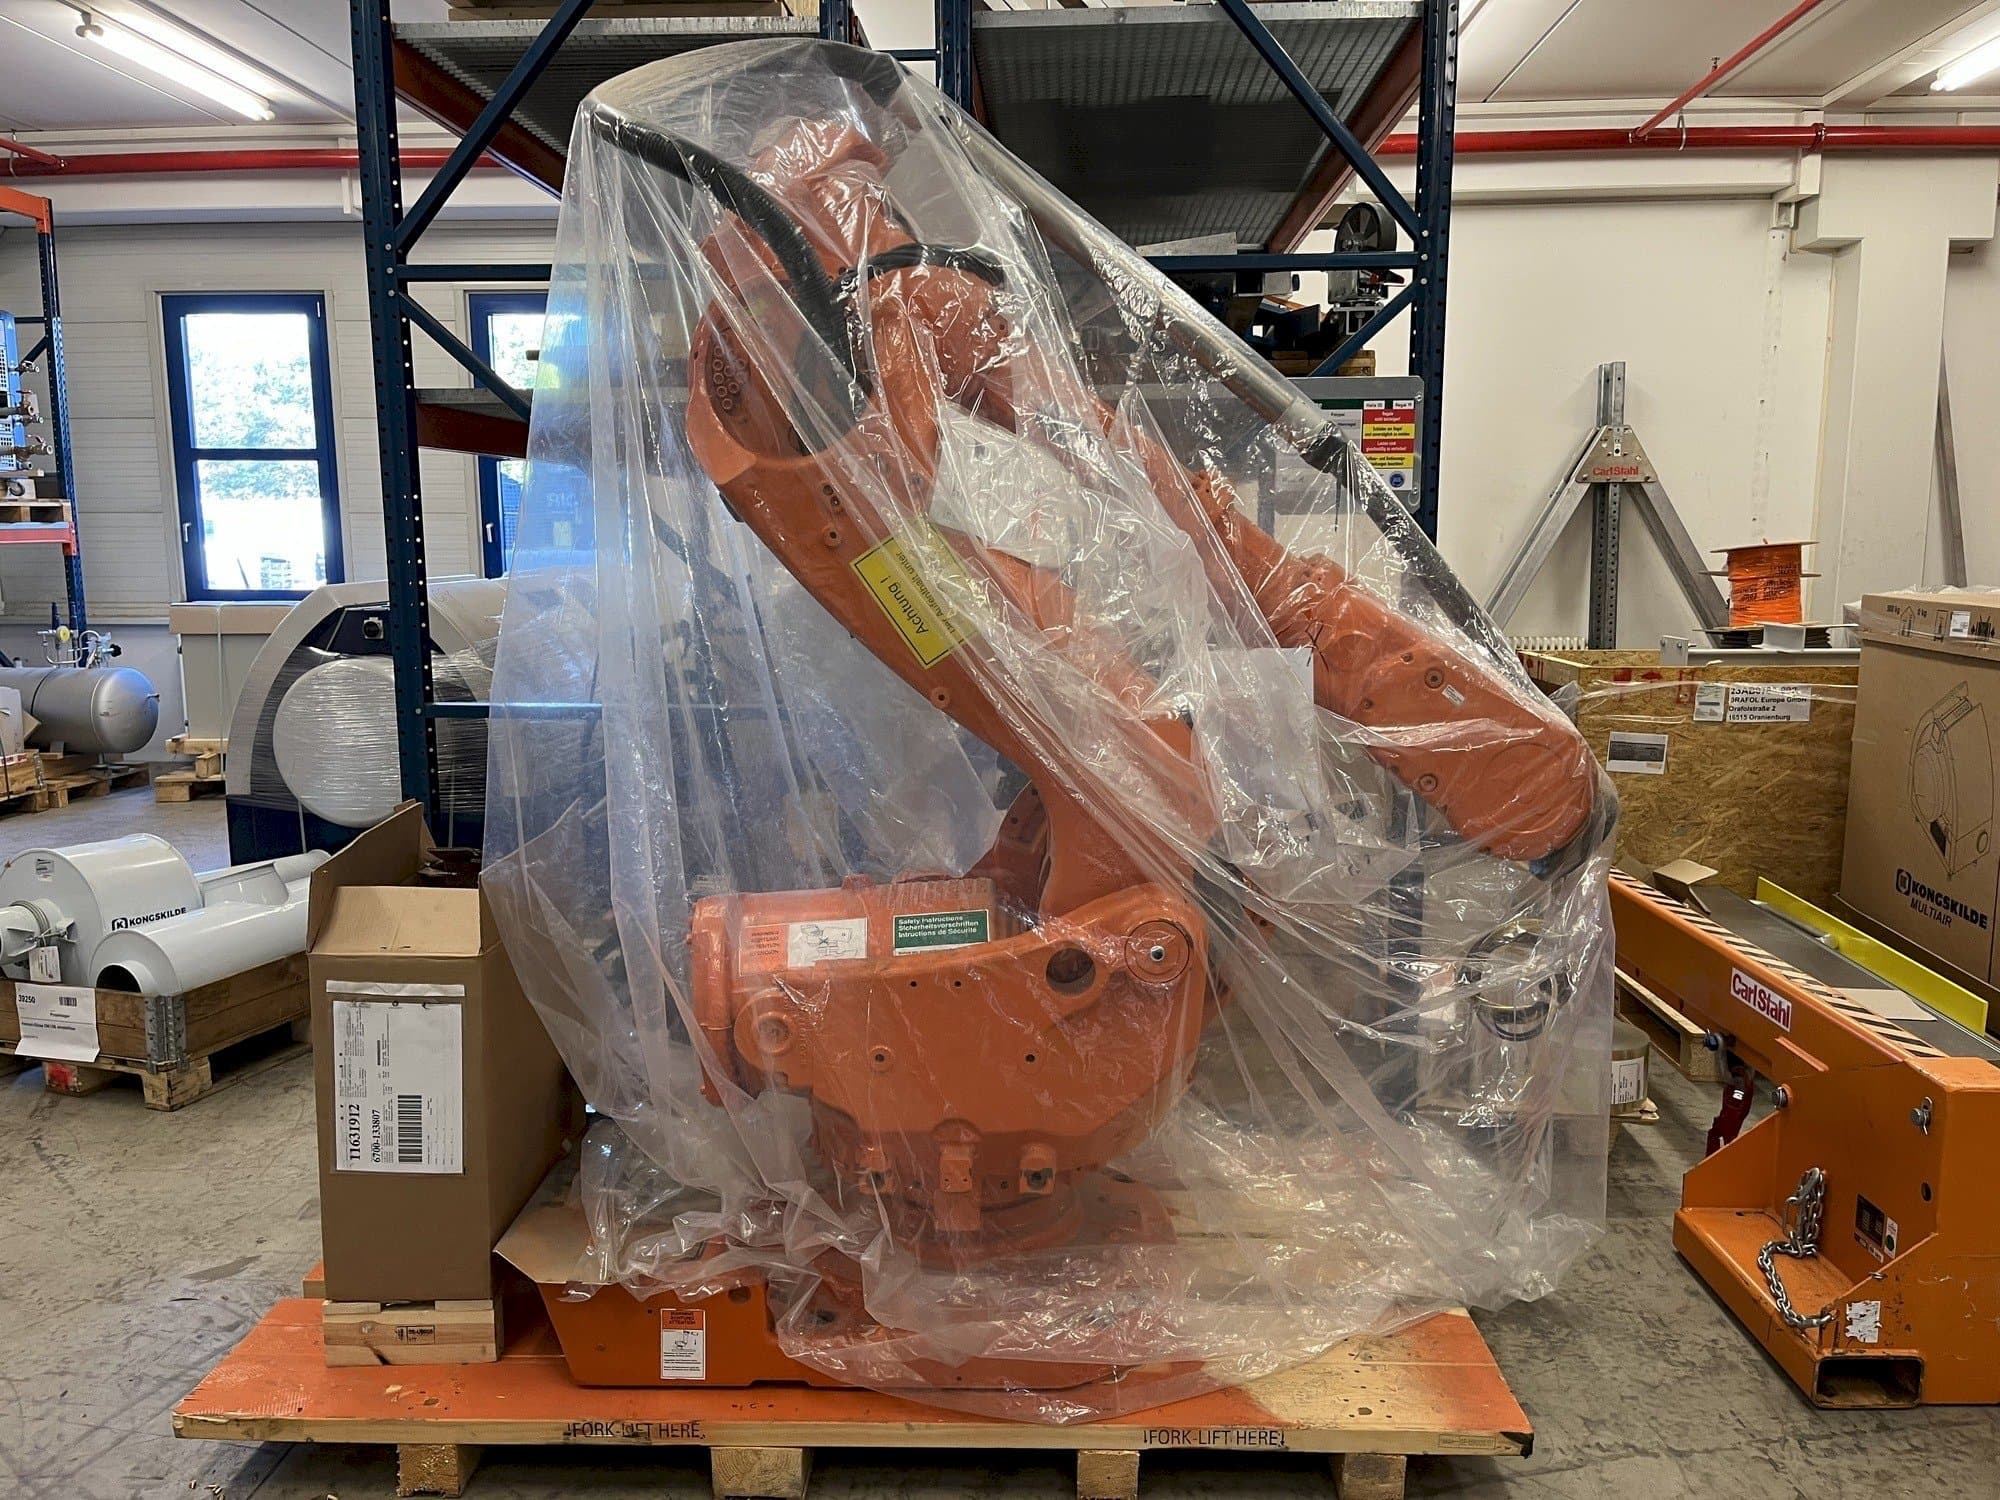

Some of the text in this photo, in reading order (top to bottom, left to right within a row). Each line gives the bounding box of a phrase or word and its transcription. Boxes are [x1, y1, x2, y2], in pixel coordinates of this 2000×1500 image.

[888, 582, 929, 635] Achtung
[129, 906, 187, 926] KONGSKILDE
[898, 921, 979, 931] Sicherheitsvorschriften
[1910, 898, 1952, 928] MULTIAIR
[1912, 880, 1988, 930] KONGSKILDE
[350, 1104, 360, 1160] 11631912
[372, 1110, 381, 1163] 6700-133807
